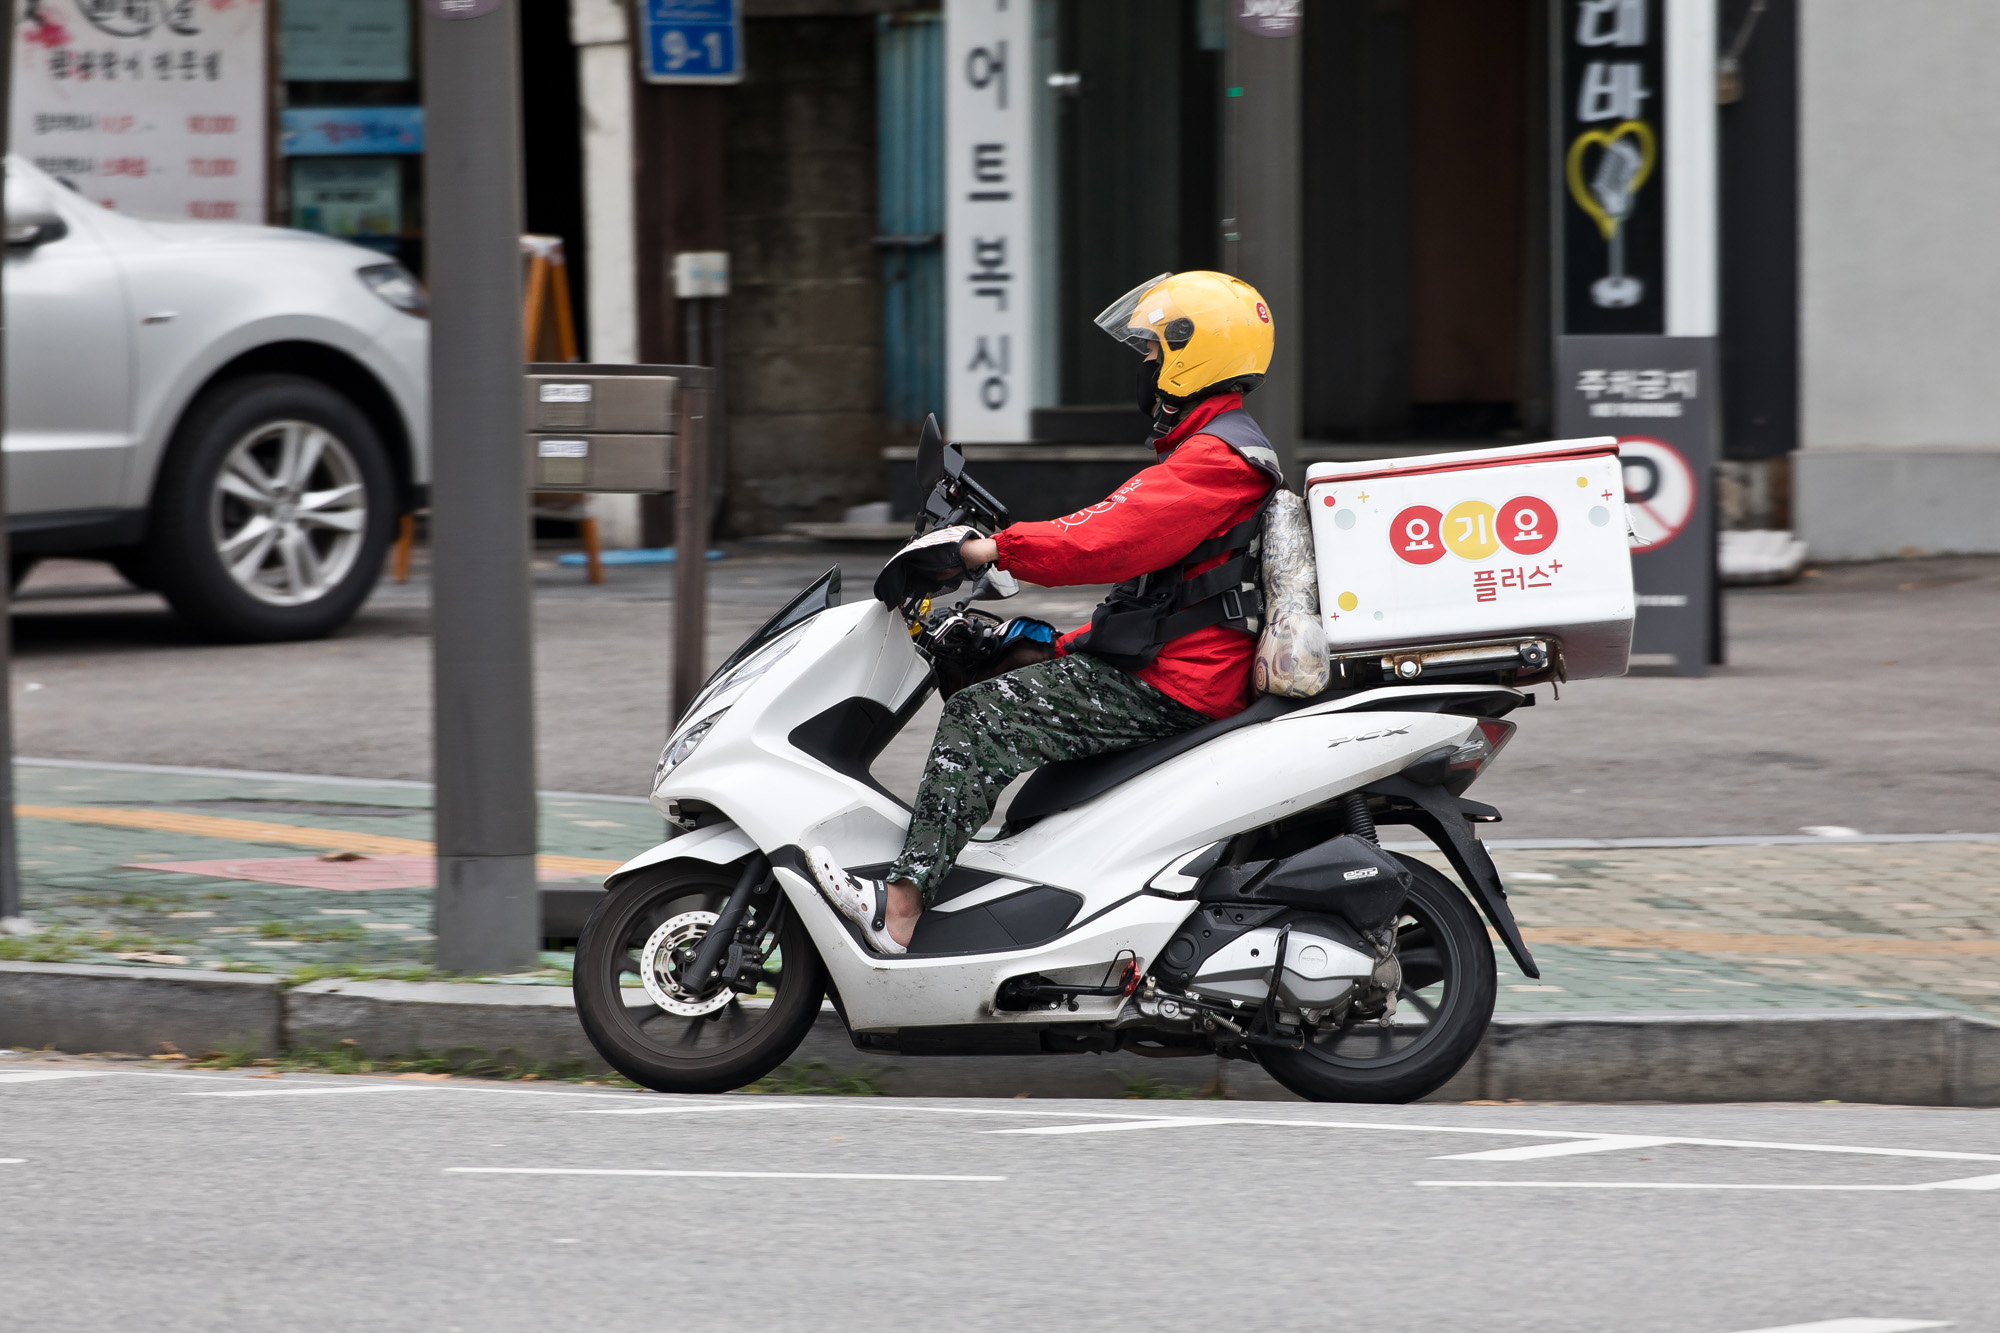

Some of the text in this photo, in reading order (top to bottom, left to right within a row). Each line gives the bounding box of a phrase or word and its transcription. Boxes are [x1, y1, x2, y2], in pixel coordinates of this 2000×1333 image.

[661, 30, 723, 70] 9-1
[1575, 369, 1697, 400] 주차금지
[1403, 507, 1545, 552] 요기요
[1327, 723, 1413, 749] PCX
